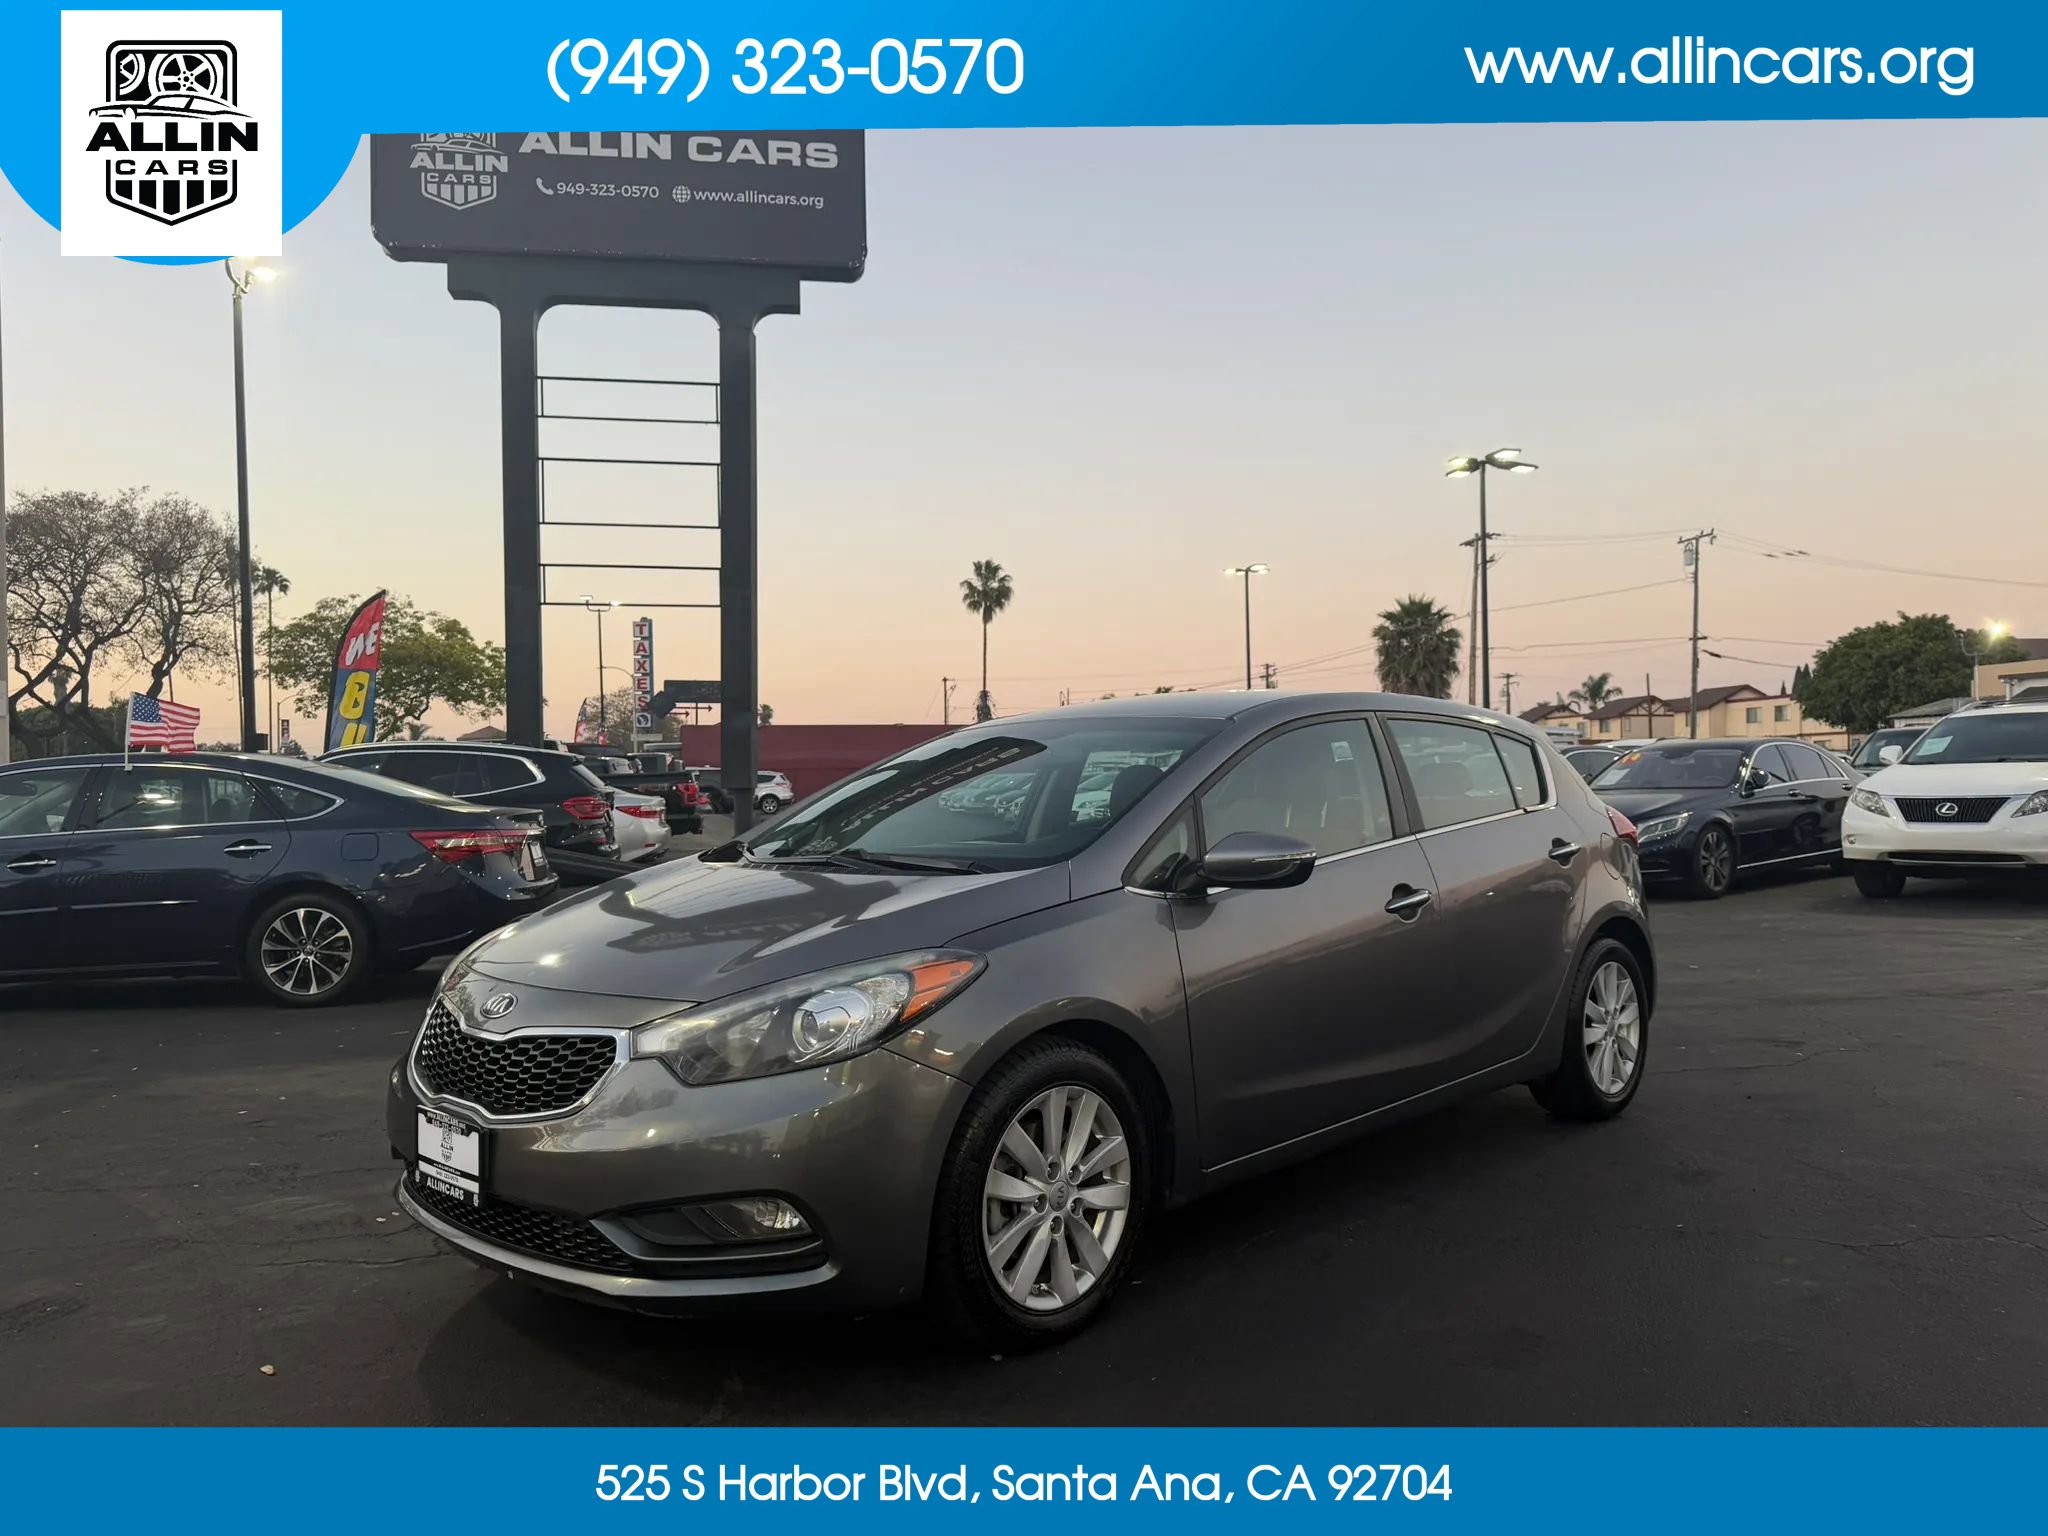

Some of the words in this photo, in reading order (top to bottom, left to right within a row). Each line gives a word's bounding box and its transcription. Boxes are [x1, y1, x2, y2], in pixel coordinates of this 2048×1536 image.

[519, 132, 672, 160] ALLIN
[688, 136, 838, 168] CARS
[414, 151, 513, 172] ALLIN
[431, 172, 497, 184] CARS
[556, 182, 659, 199] 949-323-0570
[693, 187, 824, 209] www.allincars.org
[635, 623, 649, 710] TAXES
[426, 1176, 464, 1200] ALLINCARS
